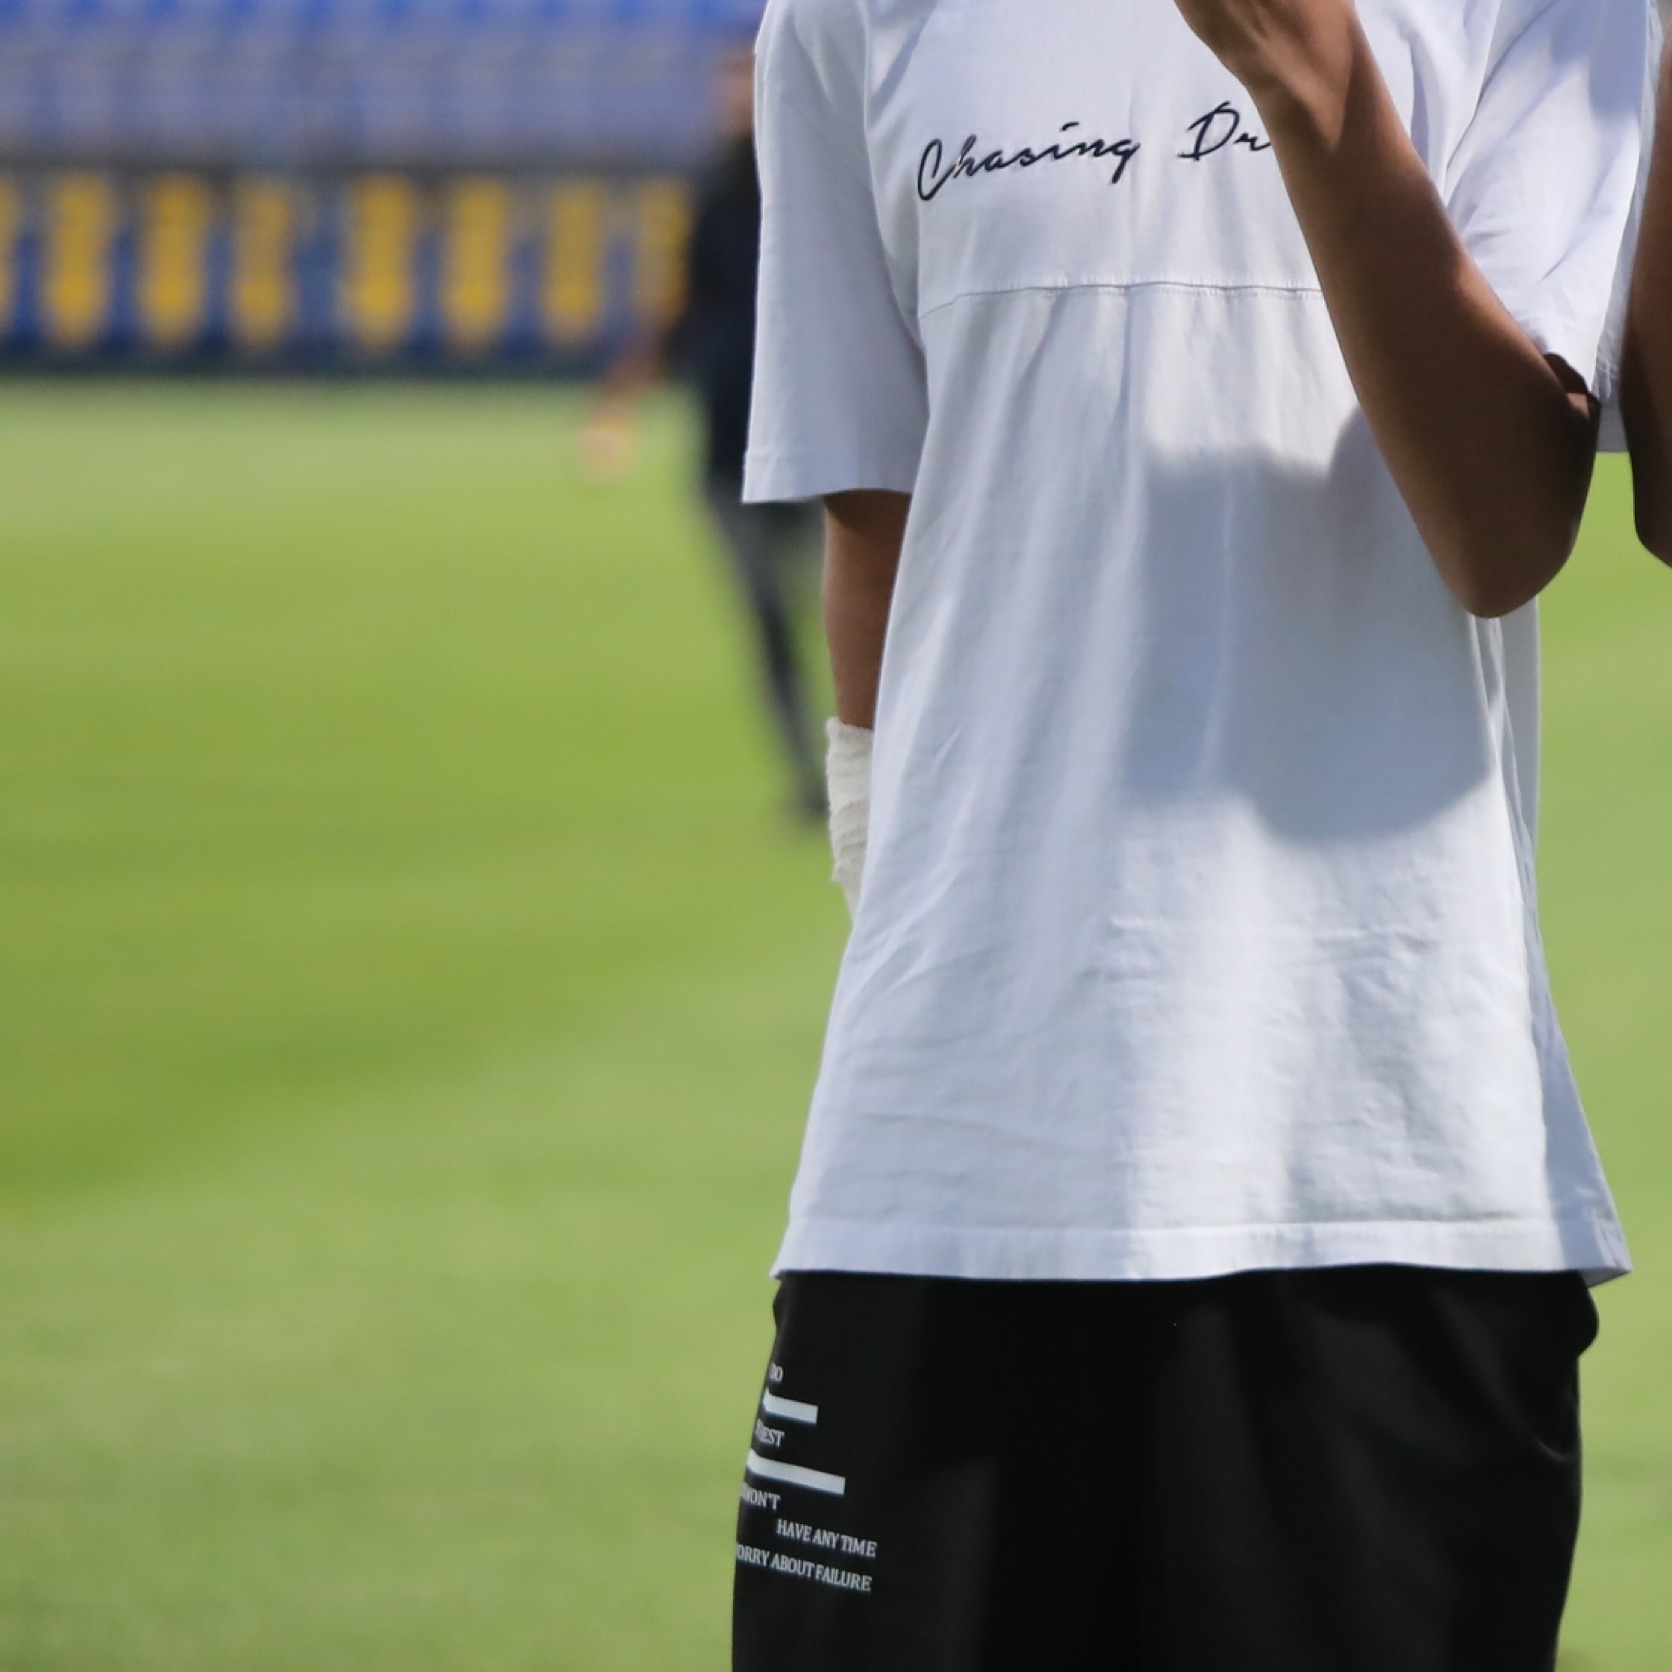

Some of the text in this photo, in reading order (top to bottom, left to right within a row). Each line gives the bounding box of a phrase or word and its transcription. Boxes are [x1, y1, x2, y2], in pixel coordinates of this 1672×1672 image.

[917, 121, 1141, 201] Chasing
[776, 1517, 878, 1559] HAVE ANY TIME
[735, 1542, 873, 1592] ORRY ABOUT FAILURE
